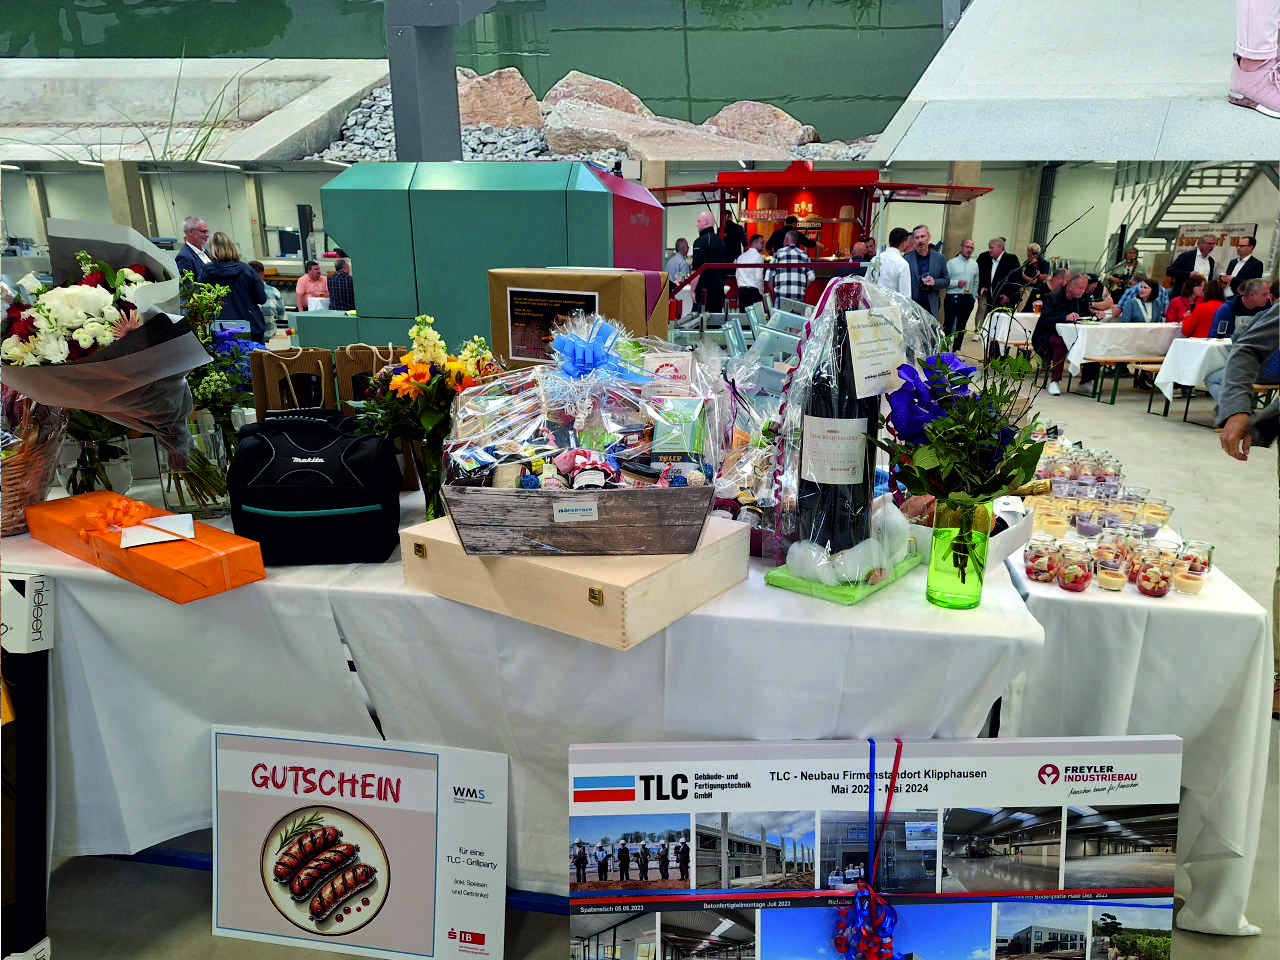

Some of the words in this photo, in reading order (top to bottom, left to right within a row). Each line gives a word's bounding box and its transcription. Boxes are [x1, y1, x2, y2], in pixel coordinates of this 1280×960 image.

[31, 580, 49, 642] nielsen
[769, 771, 791, 781] TLC
[800, 770, 840, 781] Neubau
[923, 769, 987, 781] Klipphausen
[1064, 773, 1137, 782] INDUSTRIEBAU
[251, 763, 402, 803] GUTSCHEIN
[639, 773, 689, 801] TLC
[694, 781, 752, 791] Fertigungstechnik
[831, 784, 849, 794] Mai
[905, 783, 929, 793] 2024
[453, 786, 485, 799] WMS
[458, 846, 469, 855] für
[469, 848, 485, 856] eine
[446, 855, 461, 864] TLC
[466, 857, 498, 870] Grillparty
[461, 932, 472, 942] IB
